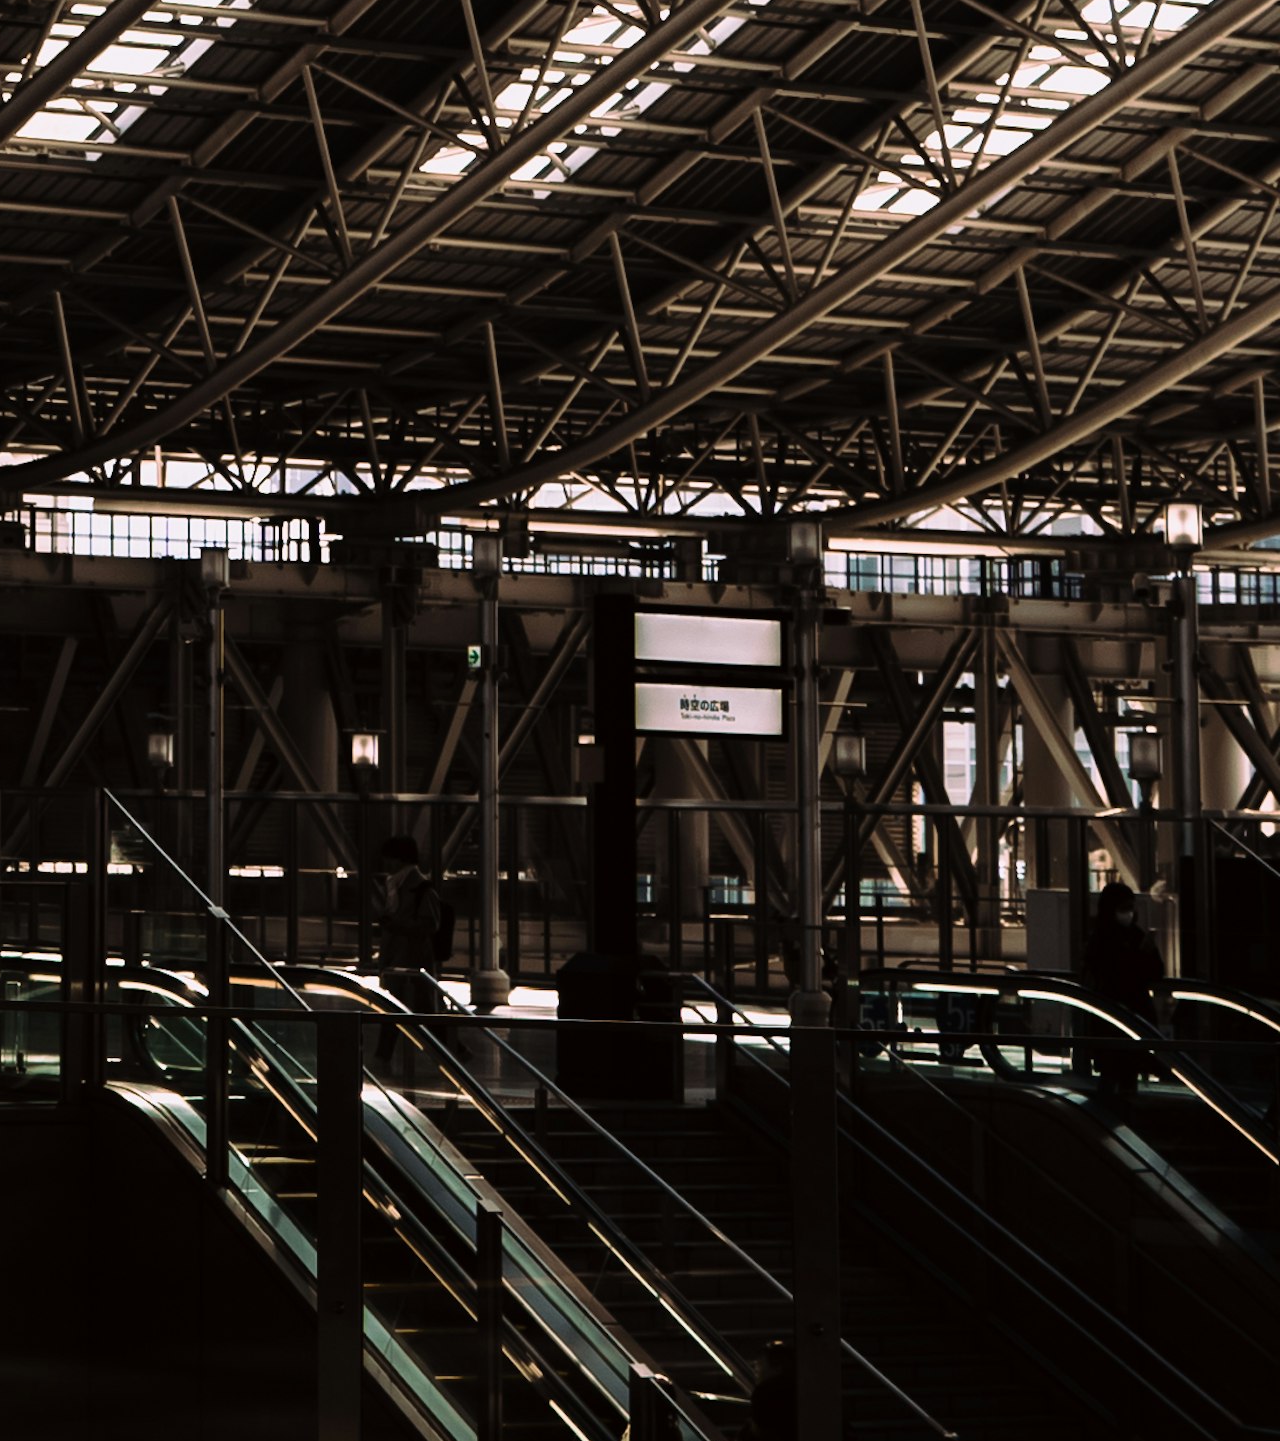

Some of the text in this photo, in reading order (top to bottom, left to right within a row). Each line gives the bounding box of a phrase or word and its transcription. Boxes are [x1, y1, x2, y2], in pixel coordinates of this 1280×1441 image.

[680, 698, 730, 713] 時空の広場
